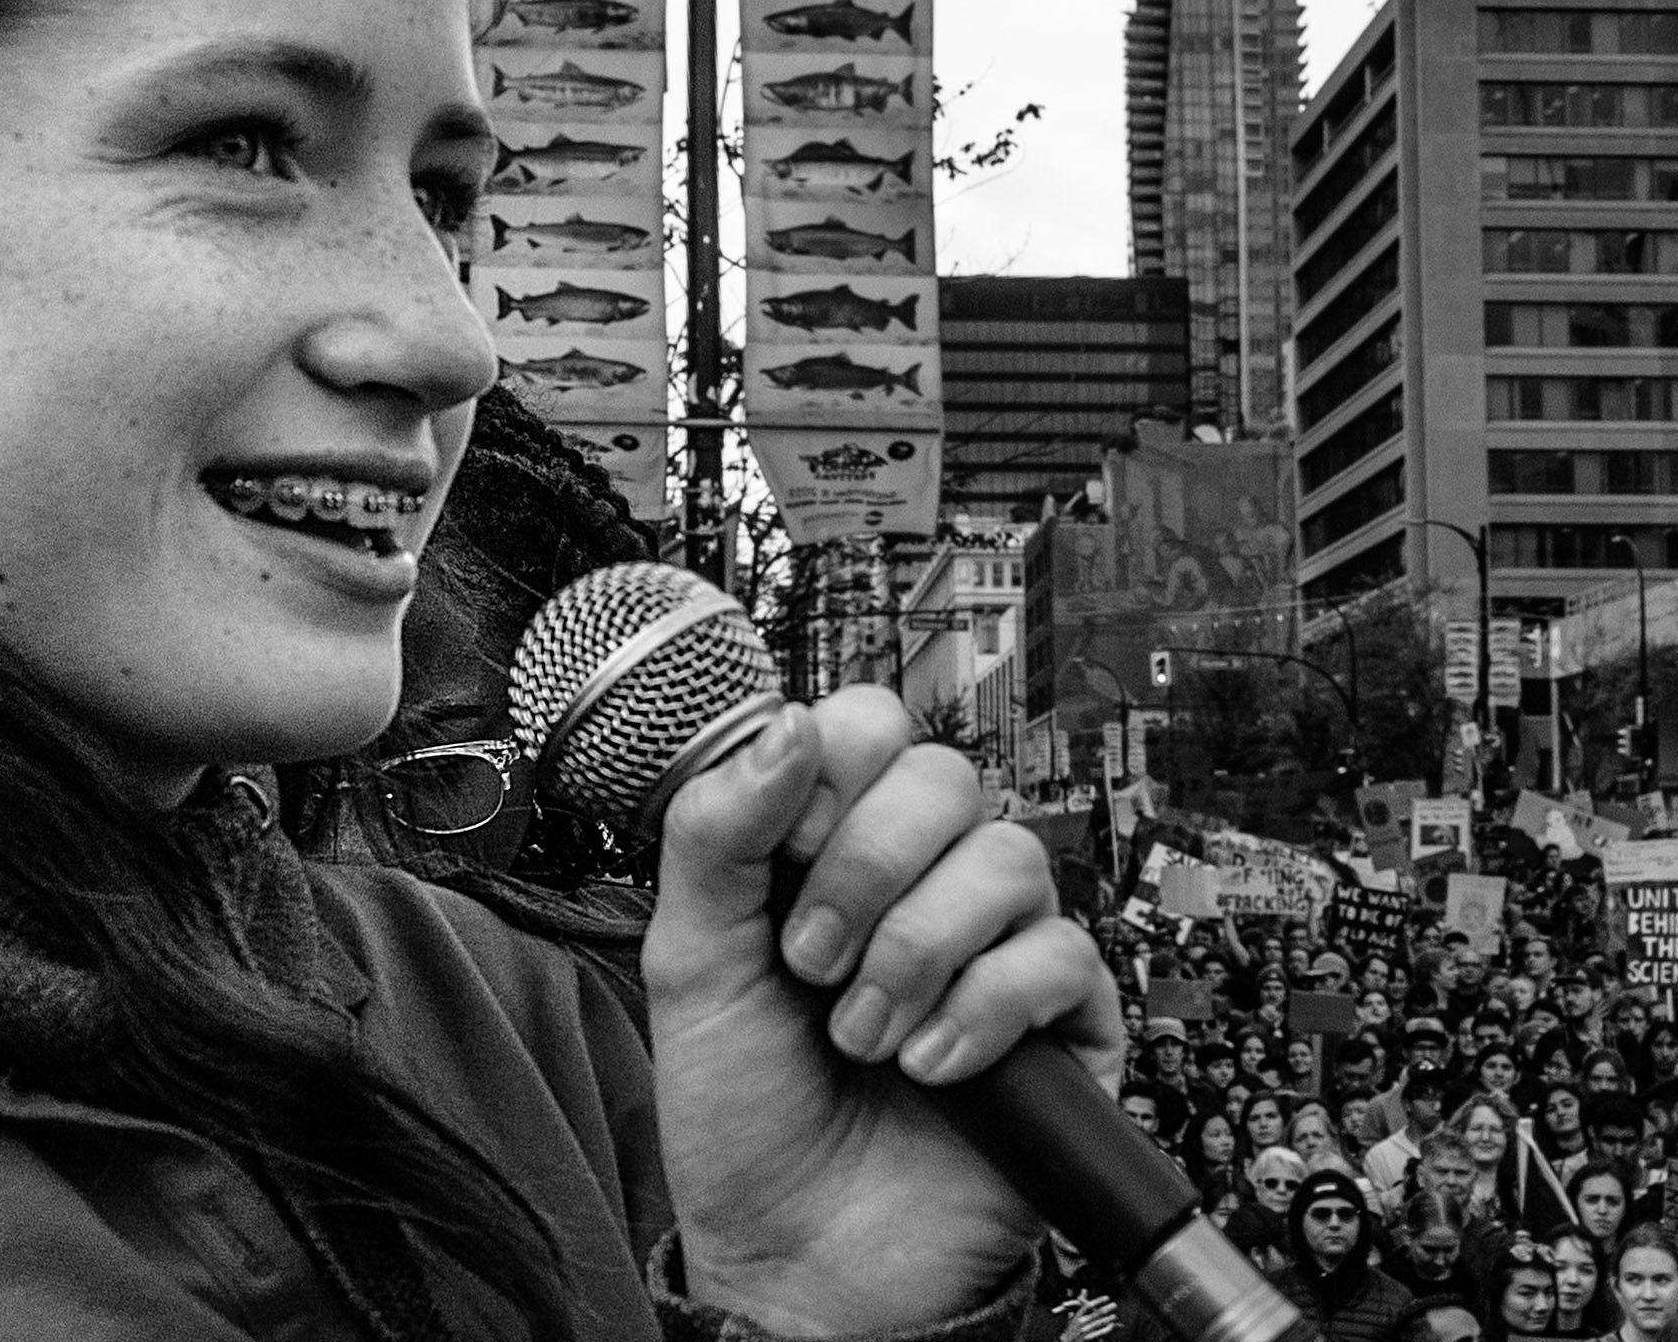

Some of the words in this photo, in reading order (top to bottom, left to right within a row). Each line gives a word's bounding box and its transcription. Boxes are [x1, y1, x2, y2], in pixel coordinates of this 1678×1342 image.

[1337, 885, 1362, 902] WE
[1367, 892, 1408, 911] WANT
[1338, 904, 1357, 921] TO
